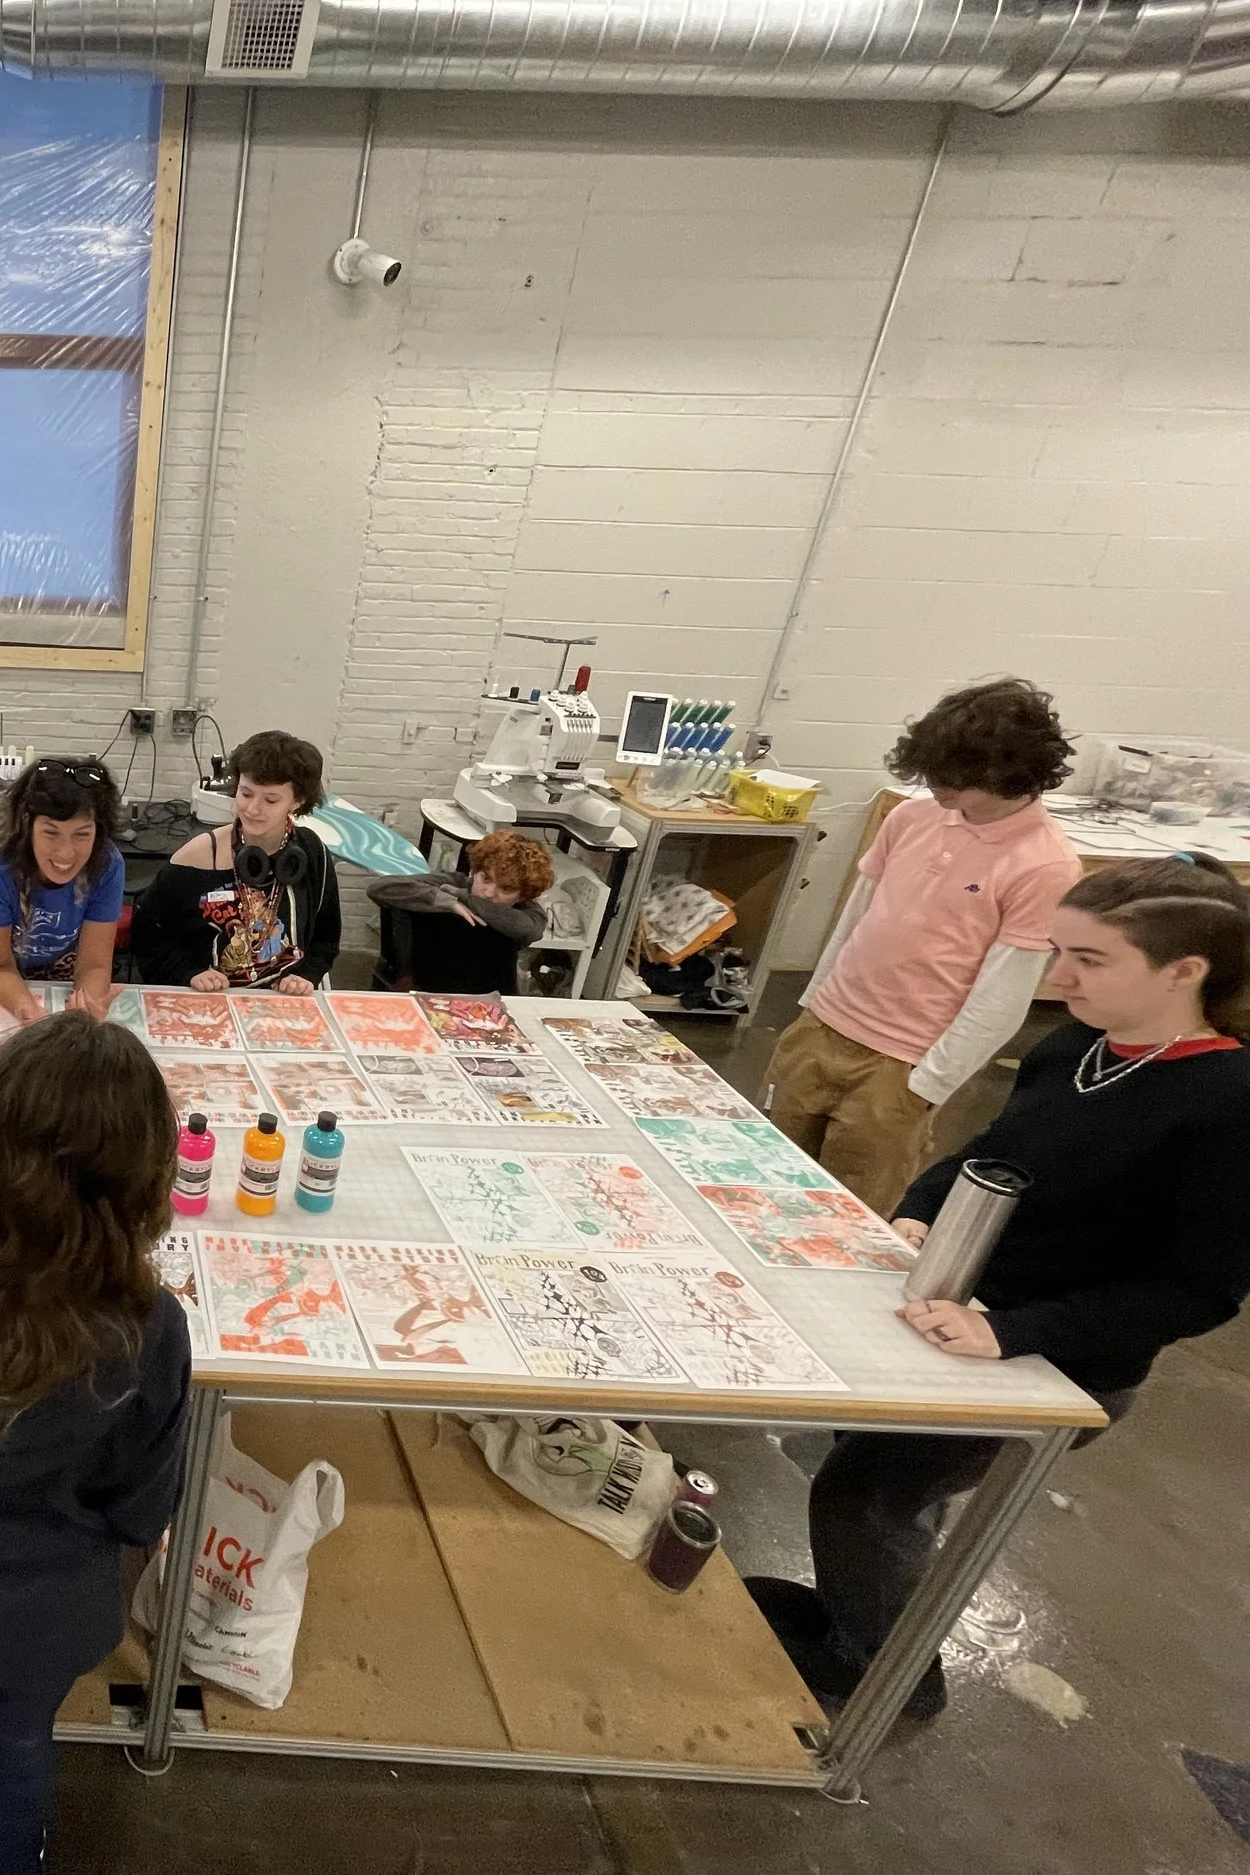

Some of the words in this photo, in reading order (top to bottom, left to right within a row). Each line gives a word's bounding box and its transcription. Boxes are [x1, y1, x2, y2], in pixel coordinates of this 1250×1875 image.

[519, 1254, 575, 1268] Power
[598, 1476, 634, 1515] TALK
[203, 1526, 265, 1590] ICK
[194, 1562, 255, 1612] aterials
